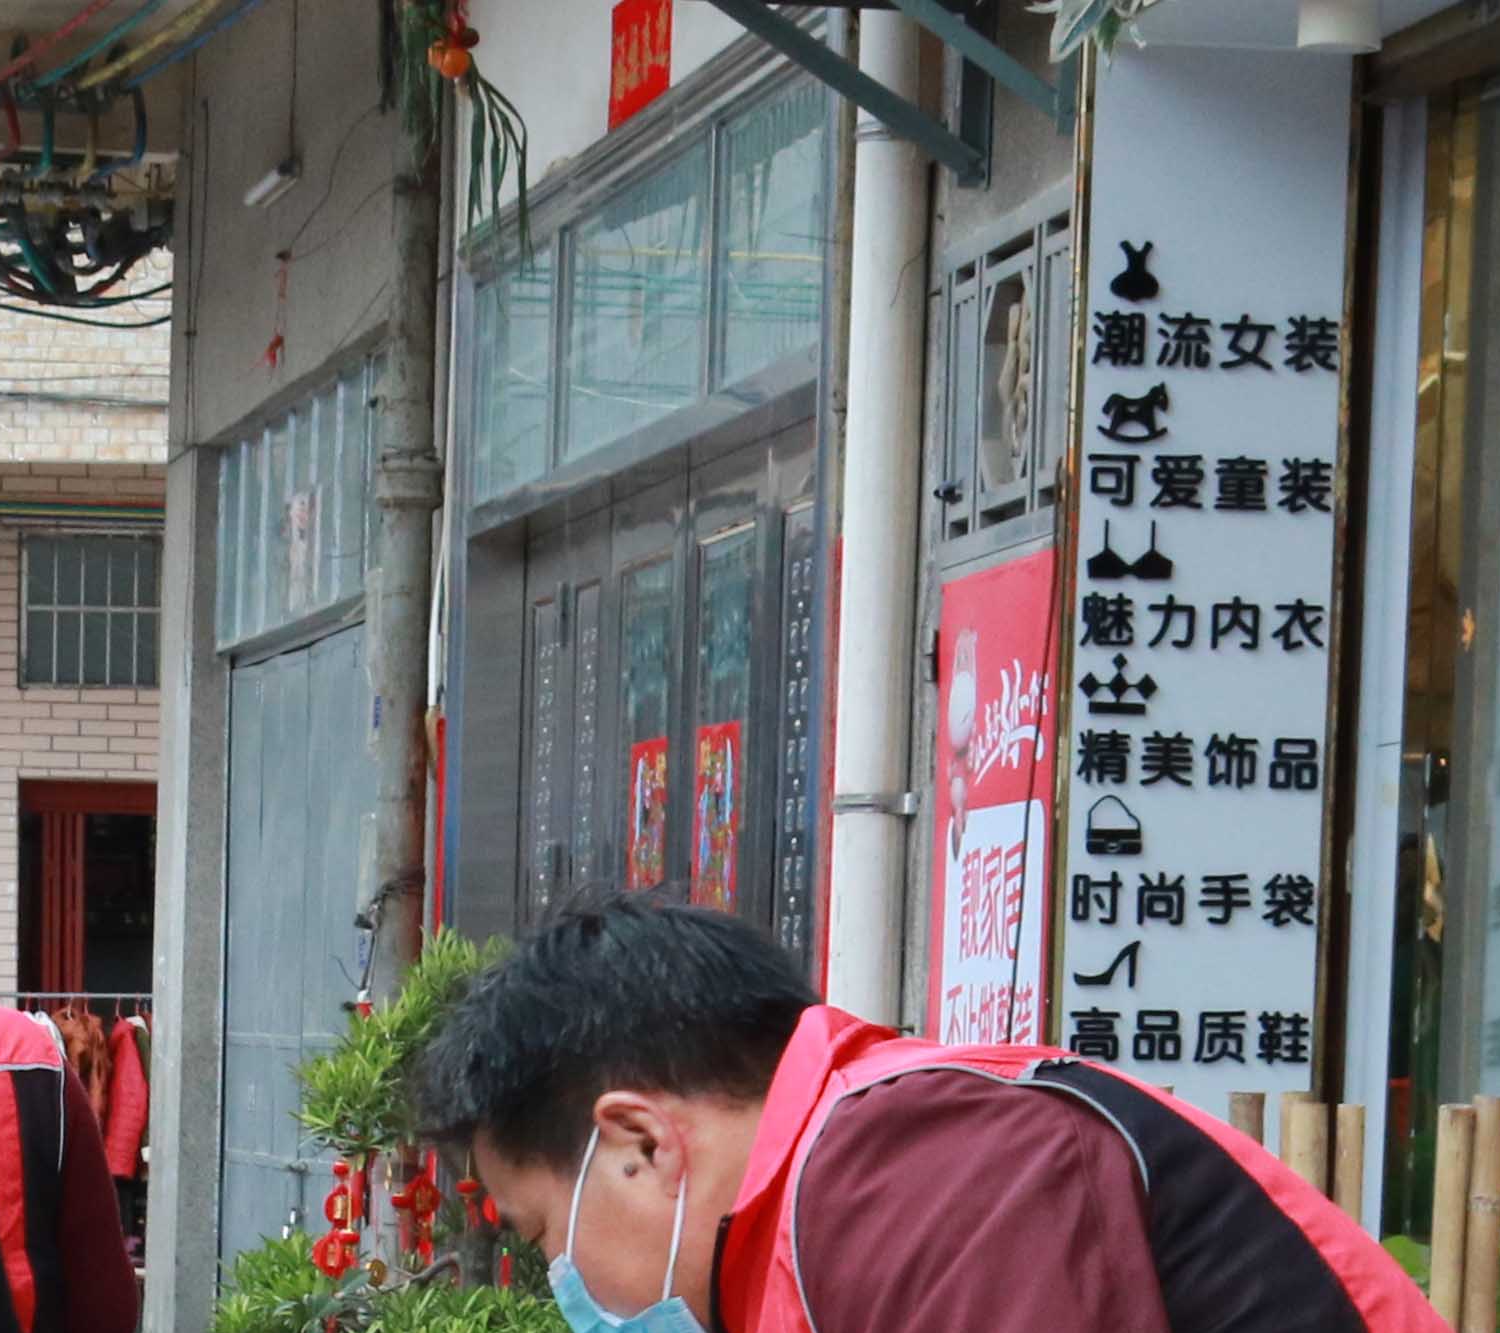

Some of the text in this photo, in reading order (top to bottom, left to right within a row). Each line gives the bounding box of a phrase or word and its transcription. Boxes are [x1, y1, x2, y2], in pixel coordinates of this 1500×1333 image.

[1091, 308, 1340, 374] 潮流女装
[1086, 452, 1334, 516] 可爱童装
[1078, 590, 1326, 652] 魅力内衣
[1075, 728, 1320, 792] 精美饰品
[957, 841, 1025, 963] 靓家居
[1070, 870, 1316, 929] 时尚手袋
[1068, 1006, 1311, 1067] 高品质鞋
